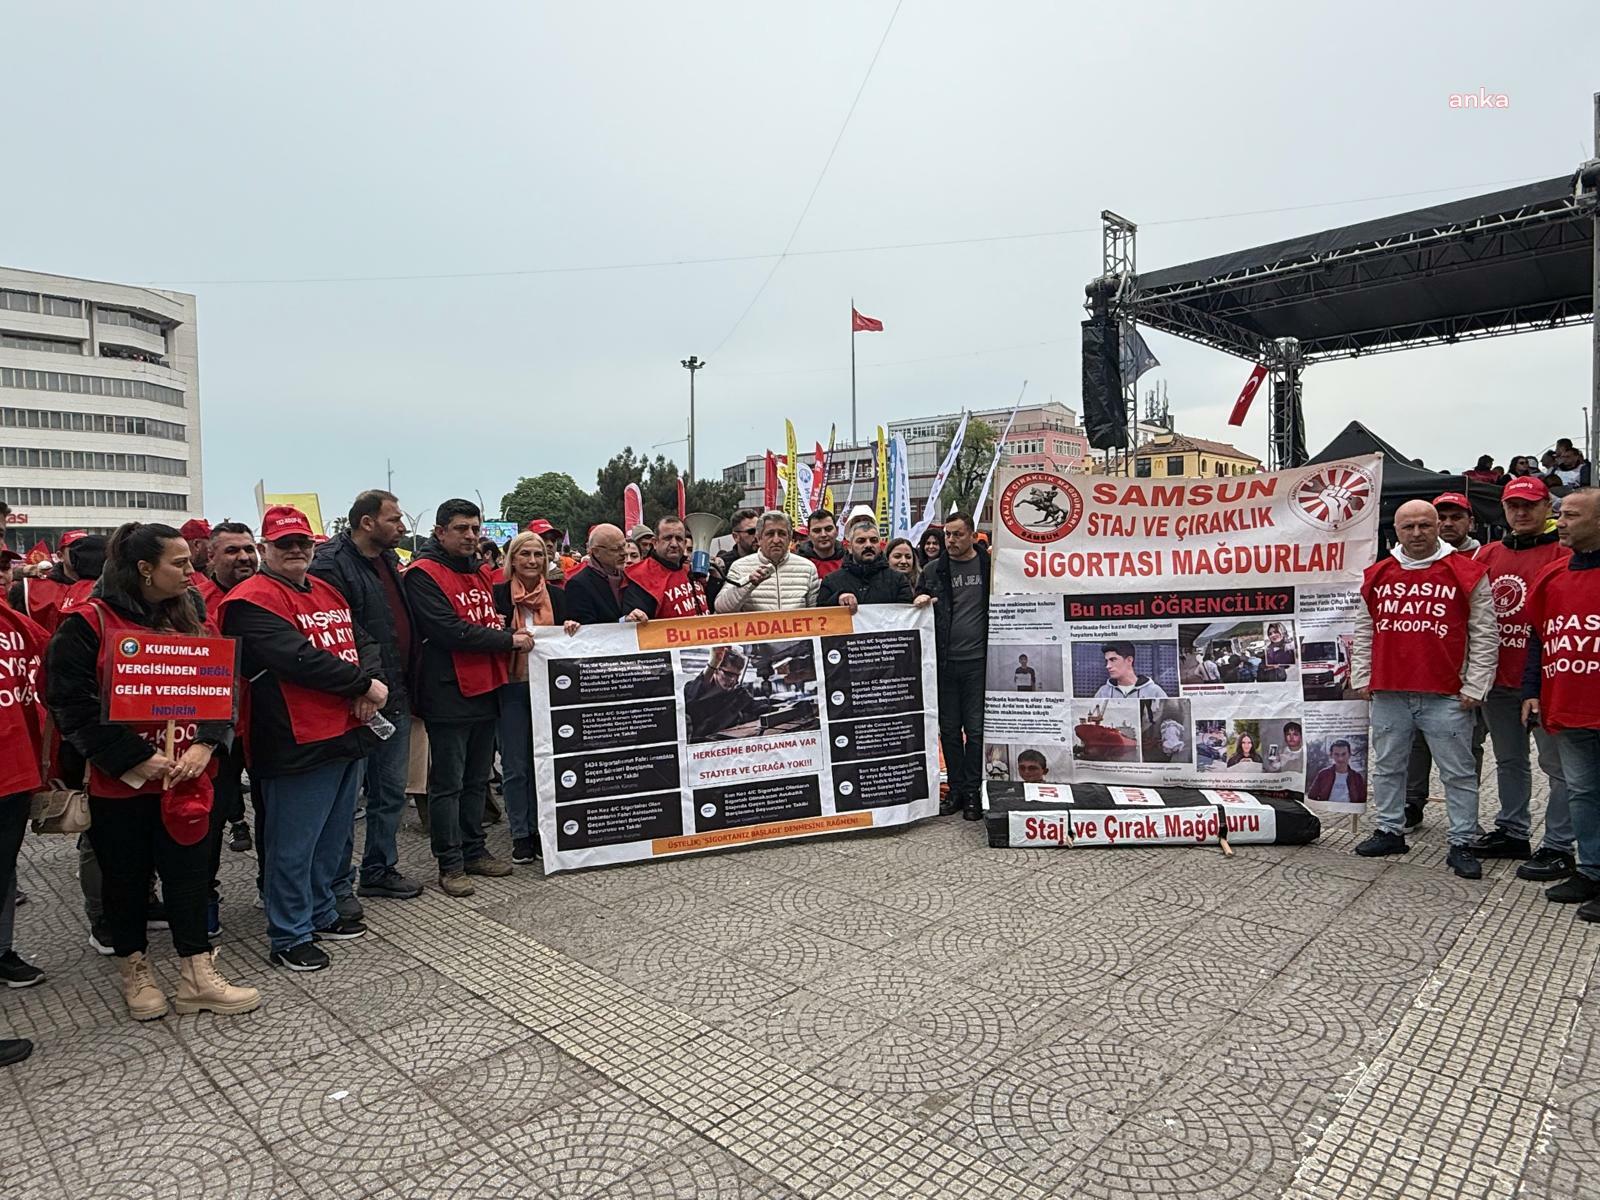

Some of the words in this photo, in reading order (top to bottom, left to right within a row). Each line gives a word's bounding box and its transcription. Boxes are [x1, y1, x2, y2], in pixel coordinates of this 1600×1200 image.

[1004, 491, 1013, 501] VE
[1092, 478, 1278, 508] SAMSUN
[1003, 506, 1013, 525] STAJ
[1088, 513, 1136, 537] STAJ
[1144, 513, 1169, 536] VE
[1175, 507, 1276, 541] ÇIRAKLIK
[1021, 532, 1059, 540] SAMSUN
[1023, 546, 1162, 578] SİGORTASI
[1172, 541, 1346, 575] MAĞDURLARI
[1374, 582, 1456, 599] YAŞASIN
[674, 604, 682, 614] 1
[1070, 603, 1094, 616] Bu
[1100, 600, 1144, 616] nasıl
[1151, 592, 1288, 615] ÖĞRENCİLİK?
[1377, 602, 1382, 615] 1
[1384, 600, 1446, 617] MAYIS
[666, 628, 690, 643] Bu
[697, 622, 739, 640] nasıl
[745, 617, 813, 637] ADALET
[818, 617, 827, 631] ?
[308, 634, 317, 648] 1
[145, 644, 209, 656] KURUMLAR
[117, 663, 196, 675] VERGİSİNDEN
[199, 665, 231, 676] DEĞİL
[115, 683, 152, 695] GELİR
[155, 684, 230, 696] VERGİSİNDEN
[152, 704, 196, 715] İNDİRİM
[693, 746, 742, 759] HERKESİME
[745, 742, 797, 752] BORÇLANMA
[800, 738, 816, 746] VAR
[700, 769, 737, 779] STAJYER
[752, 761, 784, 773] ÇIRAĞA
[787, 759, 812, 768] YOK!!!
[784, 821, 825, 833] DENMESİNE
[826, 817, 859, 827] RAĞMEN!
[1025, 817, 1064, 844] Staj
[1074, 821, 1097, 838] ve
[1104, 815, 1159, 843] Çırak
[1165, 813, 1260, 842] Mağduru
